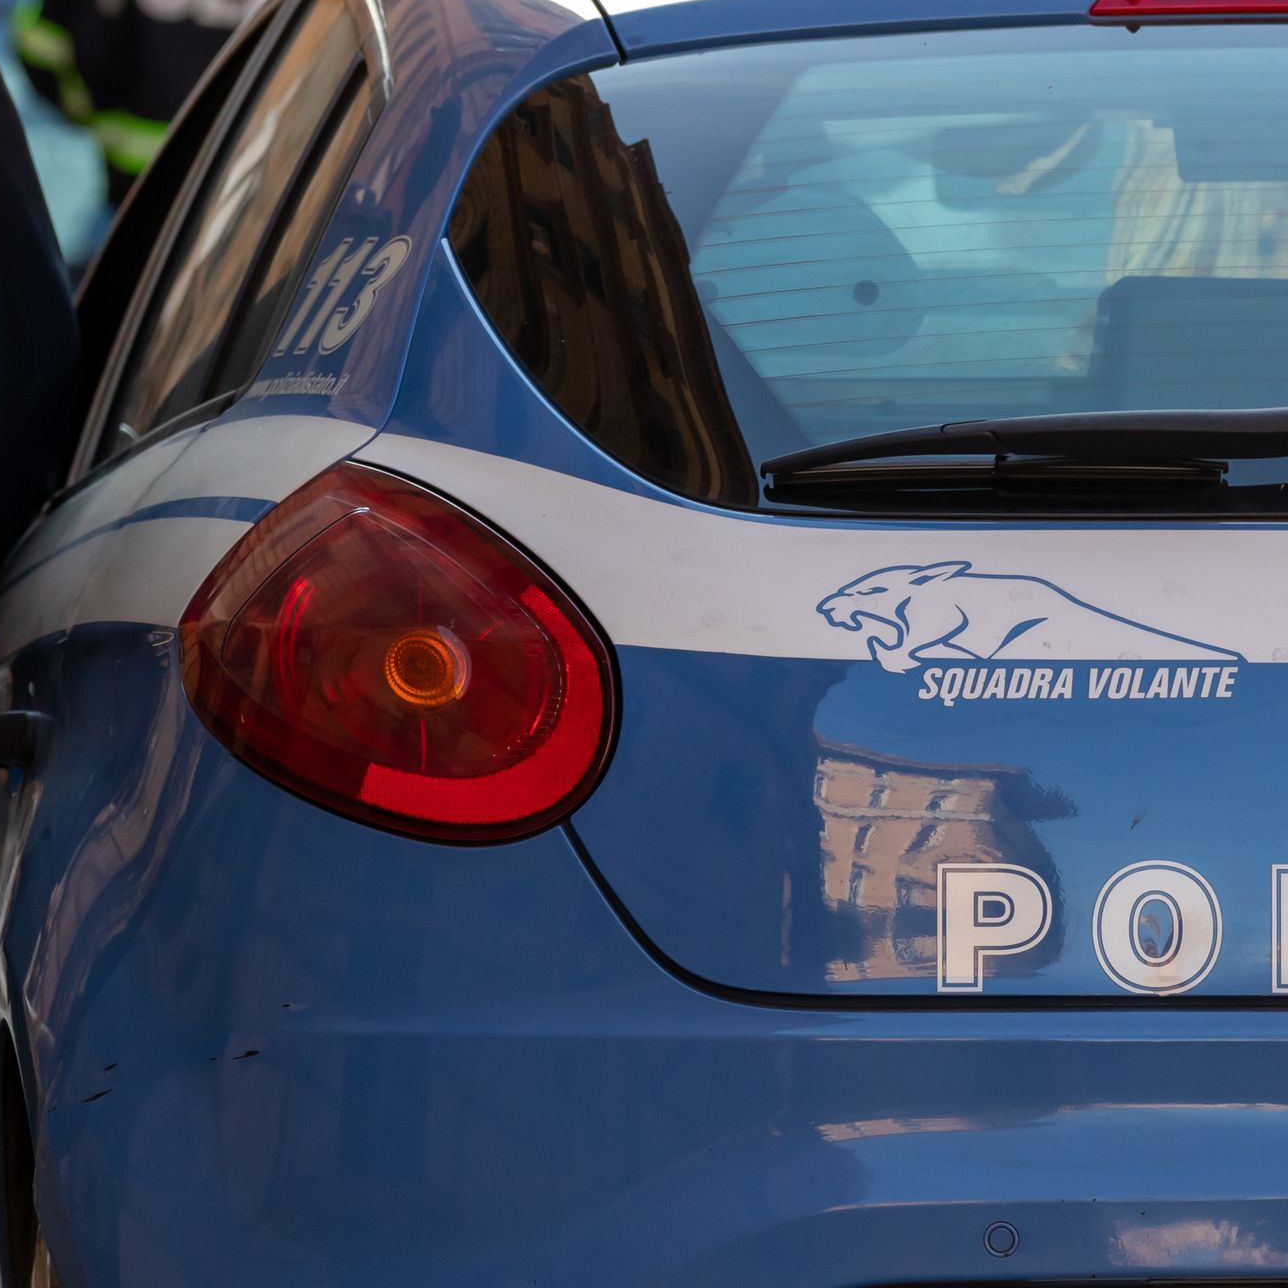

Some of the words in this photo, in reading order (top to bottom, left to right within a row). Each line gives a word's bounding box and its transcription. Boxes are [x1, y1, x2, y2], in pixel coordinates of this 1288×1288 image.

[272, 235, 412, 358] 113
[918, 667, 1073, 707] SQUADRA
[1087, 666, 1239, 699] VOLANTE
